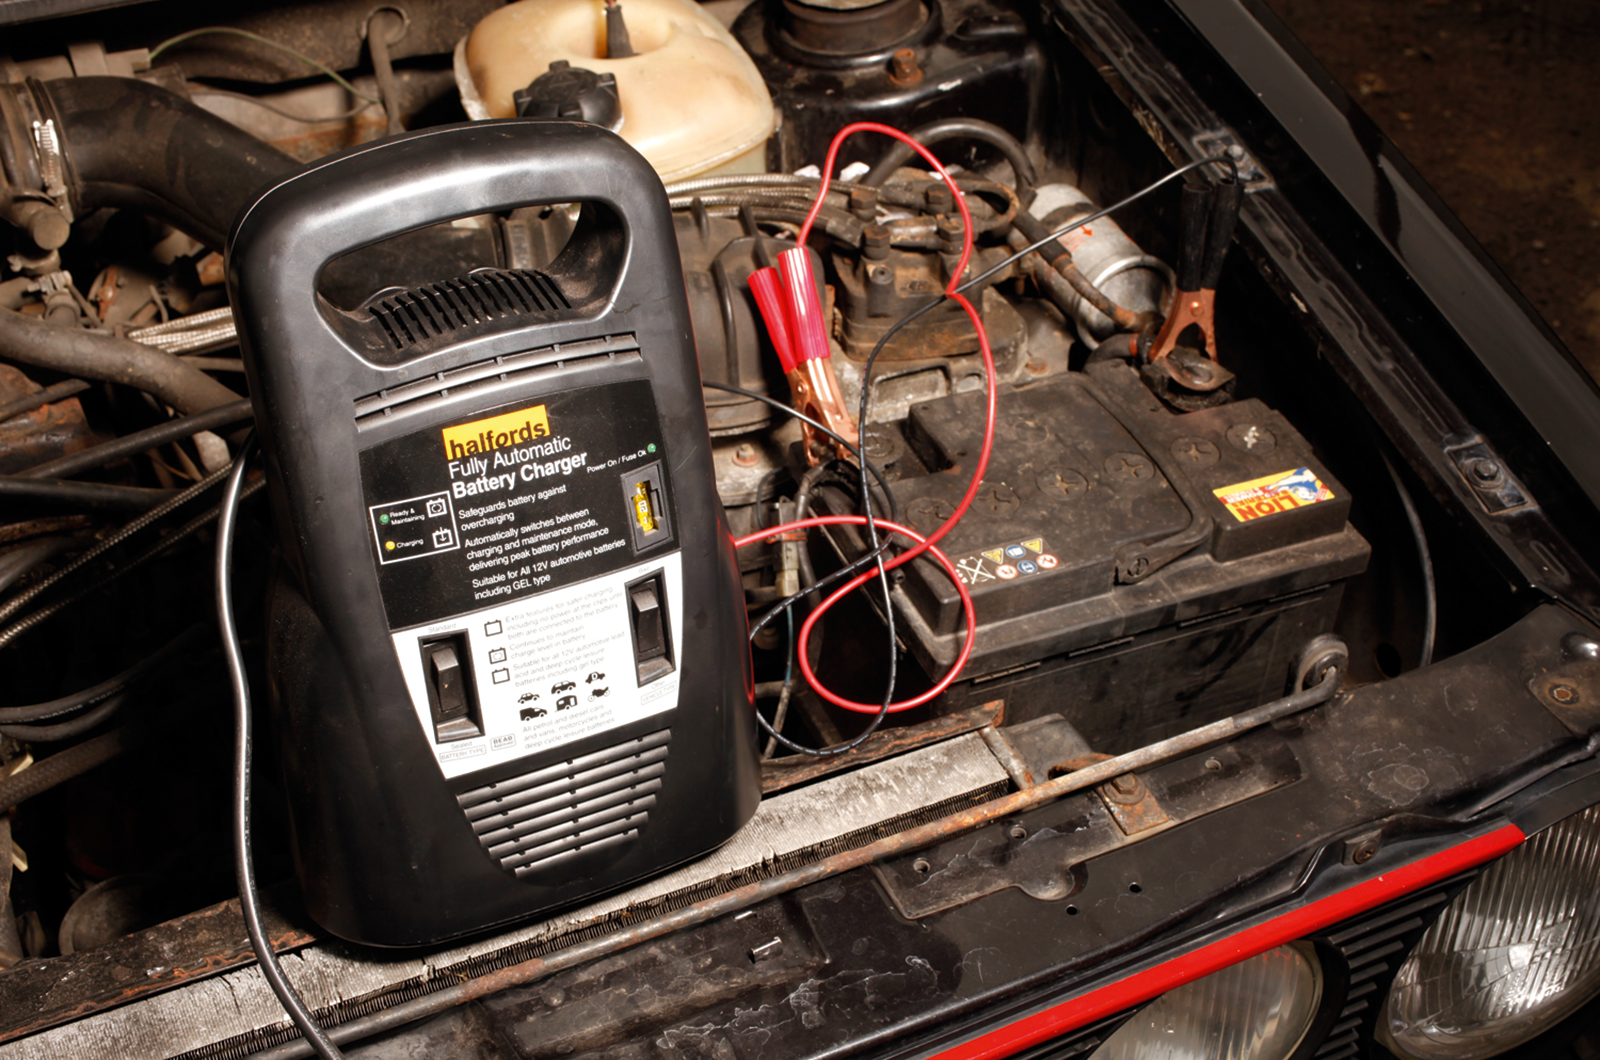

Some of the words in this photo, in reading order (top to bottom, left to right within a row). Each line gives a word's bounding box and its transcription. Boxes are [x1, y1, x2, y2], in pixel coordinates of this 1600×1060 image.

[449, 421, 545, 458] halfords
[448, 457, 487, 482] Fully
[493, 436, 571, 468] Automatic
[586, 463, 606, 473] Power
[606, 459, 617, 467] On
[621, 453, 637, 462] Fuse
[637, 449, 647, 457] Ok
[452, 472, 515, 498] Battery
[520, 452, 589, 481] Charger
[389, 509, 409, 518] Ready
[458, 501, 506, 519] Safeguards
[507, 494, 536, 507] battery
[537, 484, 566, 500] against
[1235, 495, 1300, 520] LION
[390, 514, 425, 525] Maintaining
[461, 512, 515, 531] overcharging
[464, 528, 518, 547] Automatically
[520, 518, 555, 533] switches
[555, 508, 589, 524] between
[396, 538, 424, 548] Charging
[466, 545, 503, 560] charging
[504, 538, 520, 551] and
[521, 526, 572, 545] maintenance
[573, 518, 598, 531] mode,
[468, 556, 509, 571] delivering
[510, 549, 531, 563] peak
[531, 542, 559, 555] battery
[560, 527, 609, 549] performance
[472, 573, 506, 588] Suitable
[506, 570, 518, 579] for
[520, 565, 531, 576] All
[532, 560, 548, 572] 12V
[550, 549, 592, 568] automotive
[593, 539, 626, 555] batteries
[474, 585, 512, 599] including
[512, 578, 532, 590] GEL
[532, 574, 551, 586] type
[505, 614, 524, 623] Extra
[525, 606, 554, 617] features
[566, 597, 582, 606] safer
[584, 586, 613, 600] charging
[506, 619, 538, 631] including
[550, 609, 570, 620] power
[592, 598, 608, 606] clips
[609, 591, 622, 601] until
[428, 623, 456, 633] Standard
[507, 631, 524, 640] both
[525, 628, 537, 636] are
[538, 616, 574, 632] connected
[595, 604, 618, 614] battery
[509, 637, 545, 651] Continues
[555, 625, 584, 637] maintain
[510, 649, 535, 659] charge
[537, 643, 553, 652] level
[562, 635, 585, 645] battery
[512, 659, 540, 670] Suitable
[551, 652, 559, 660] all
[561, 648, 574, 656] 12V
[575, 637, 610, 652] automotive
[610, 631, 625, 640] lead
[514, 670, 529, 679] acid
[530, 666, 544, 674] and
[545, 661, 563, 670] deep
[563, 655, 582, 665] cycle
[583, 647, 605, 658] leisure
[514, 675, 545, 687] batteries
[547, 665, 578, 678] including
[578, 662, 589, 670] gel
[590, 656, 604, 665] type
[663, 683, 676, 695] TYPE
[523, 733, 537, 741] and
[558, 715, 598, 731] motorcycles
[599, 709, 612, 718] and
[524, 740, 542, 749] deep
[543, 735, 562, 744] cycle
[563, 727, 585, 738] leisure
[586, 717, 615, 731] batteries
[532, 720, 553, 731] petrol
[554, 715, 568, 724] and
[568, 709, 588, 720] diesel
[589, 704, 604, 713] cars
[440, 751, 467, 760] BATTERY
[451, 740, 473, 751] Sealed
[493, 735, 513, 745] BEAB
